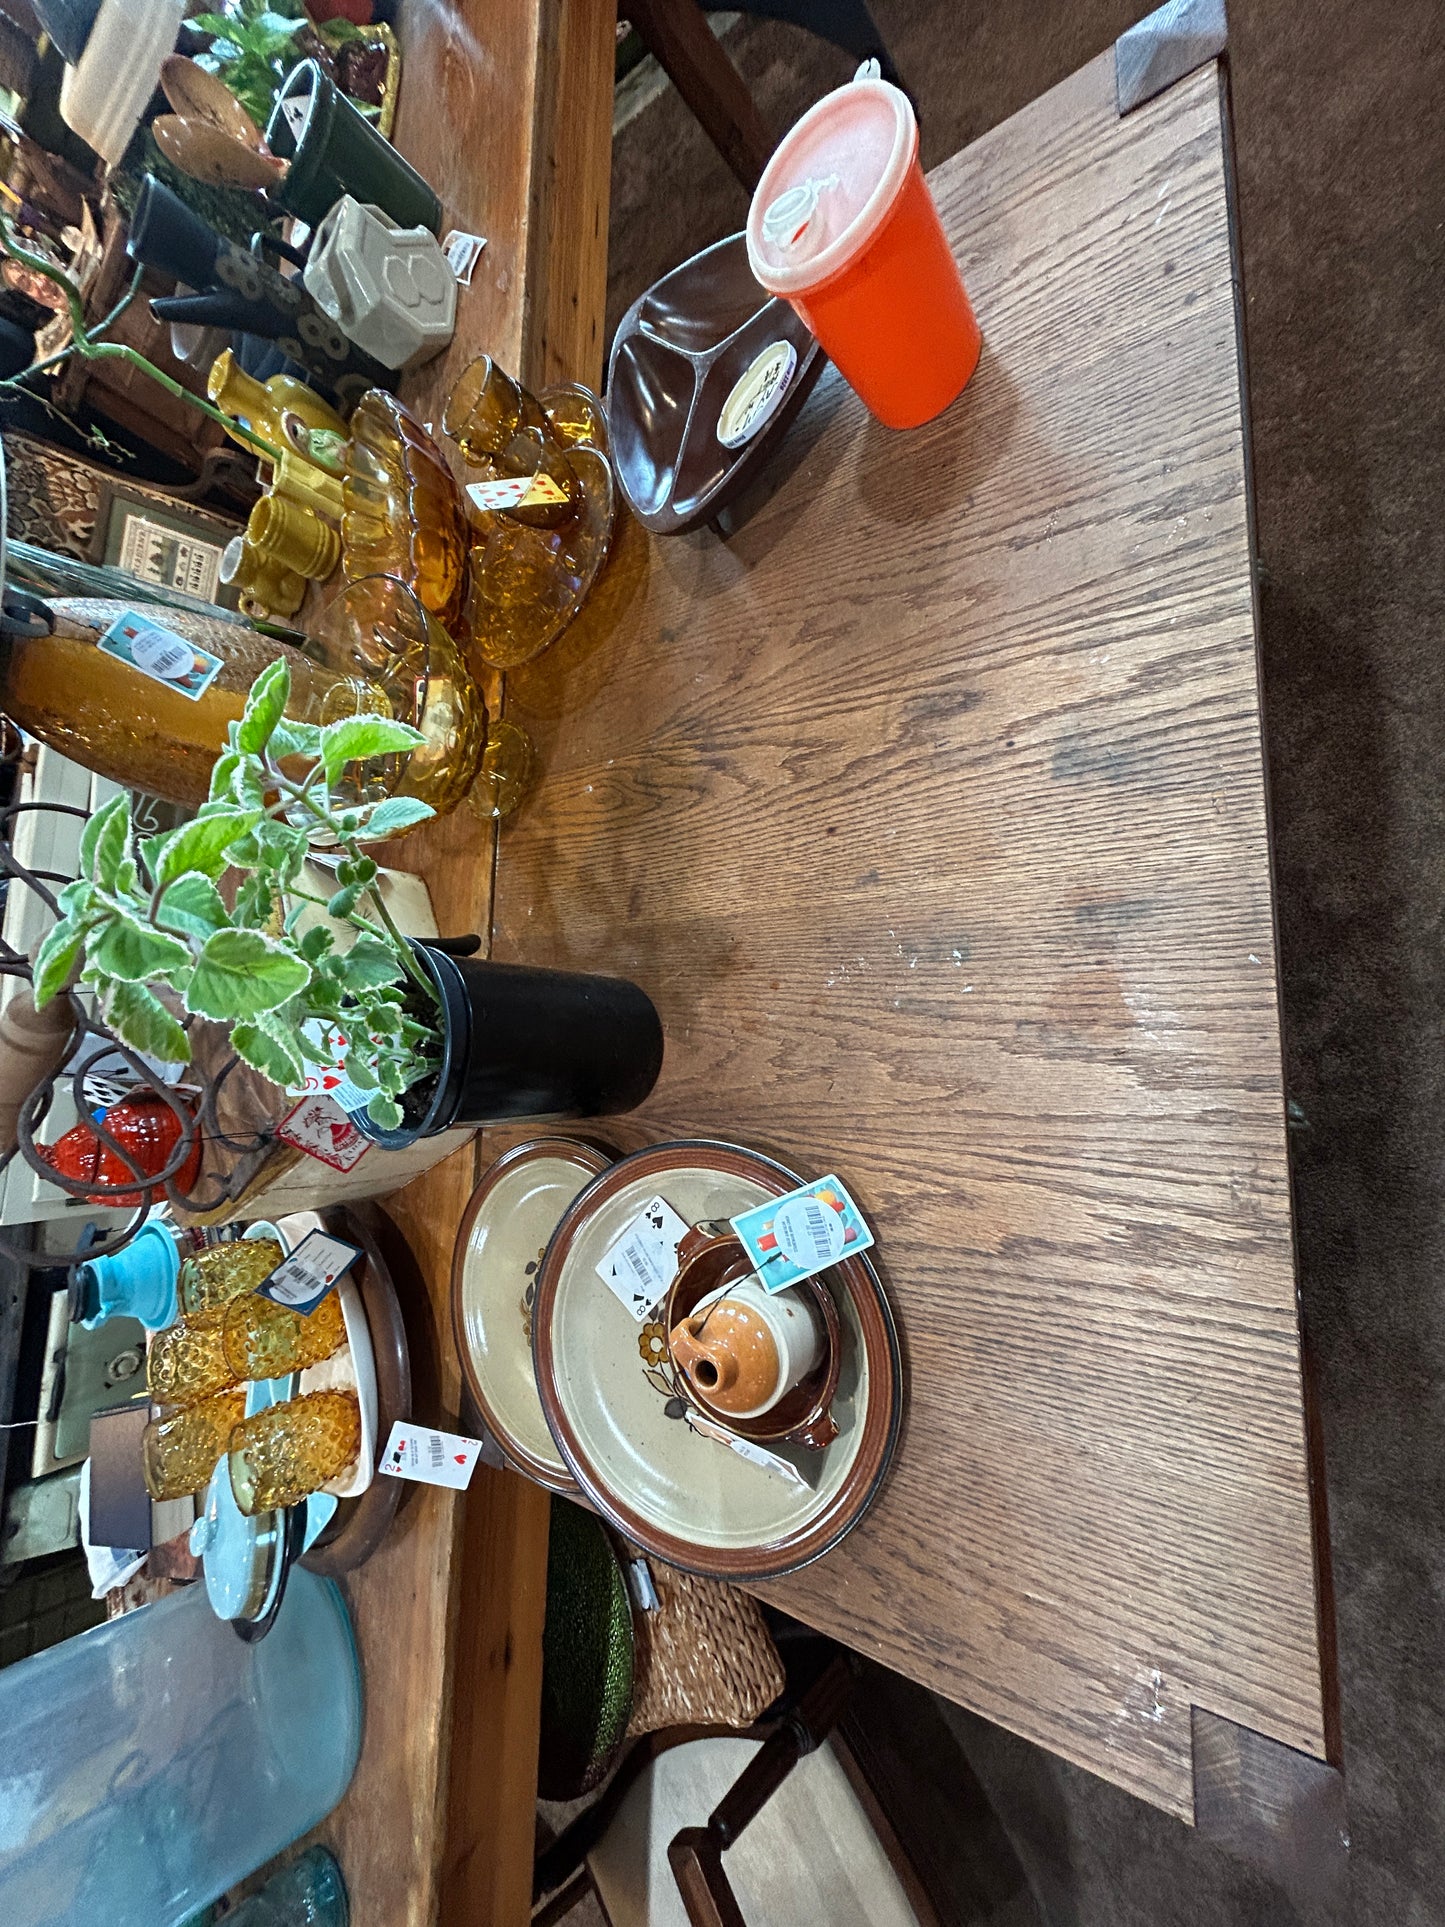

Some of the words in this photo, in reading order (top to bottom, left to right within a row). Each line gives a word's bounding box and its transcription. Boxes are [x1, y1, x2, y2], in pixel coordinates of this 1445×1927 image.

[651, 1202, 660, 1212] 8
[637, 1305, 646, 1316] 8
[384, 1463, 396, 1472] 2
